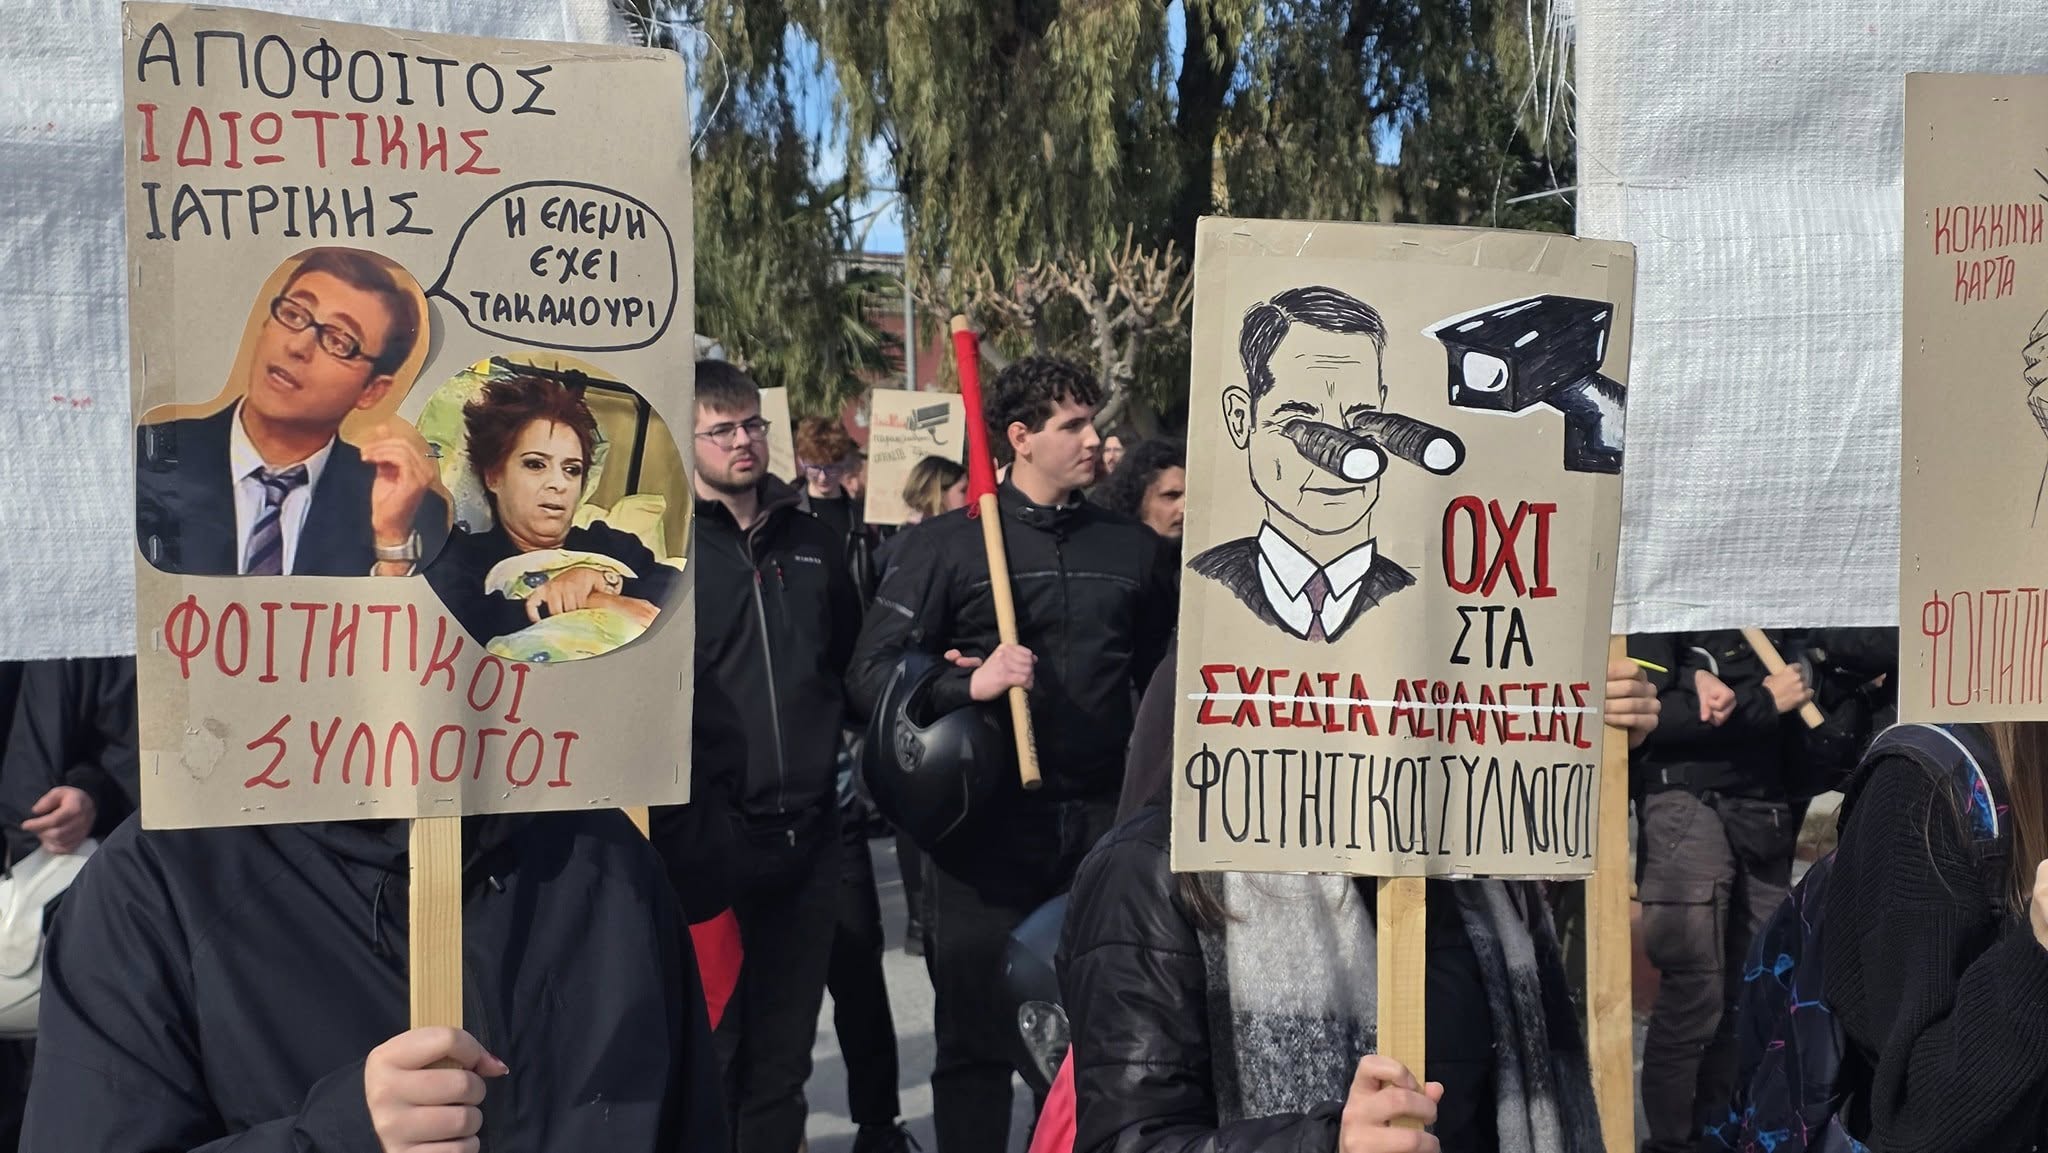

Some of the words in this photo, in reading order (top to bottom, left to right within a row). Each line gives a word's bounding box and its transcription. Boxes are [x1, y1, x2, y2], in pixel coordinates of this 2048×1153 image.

[138, 22, 556, 115] ΑΠΟΦΟΙΤΟΣ
[137, 103, 500, 175] ΙΔΙΩΤΙΚΗΣ
[142, 182, 433, 241] ΙΑΤΡΙΚΗΣ
[505, 197, 526, 239] Η
[540, 196, 646, 240] ΕΛΕΝΗ
[1935, 203, 2043, 255] ΚΟΚΚΙΝΗ
[530, 245, 617, 284] ΕΧΕΙ
[1955, 255, 2015, 305] ΚΑΡΤΑ
[470, 291, 656, 328] ΤΑΚΑΜΟΥΡΙ
[1442, 495, 1557, 599] ΟΧΙ
[164, 594, 531, 723] ΦΟΙΤΗΤΙΚΟΙ
[1450, 605, 1534, 669] ΣΤΑ
[1197, 664, 1379, 736] ΣΧΕΔΙΑ
[1388, 678, 1592, 749] ΑΣΦΑΛΕΙΑΣ
[244, 714, 579, 789] ΣΥΛΛΟΓΟΙ
[1185, 743, 1431, 856] ΦΟΙΤΗΤΙΚΟΙ
[1438, 755, 1596, 859] ΣΥΛΛΟΓΟΙ
